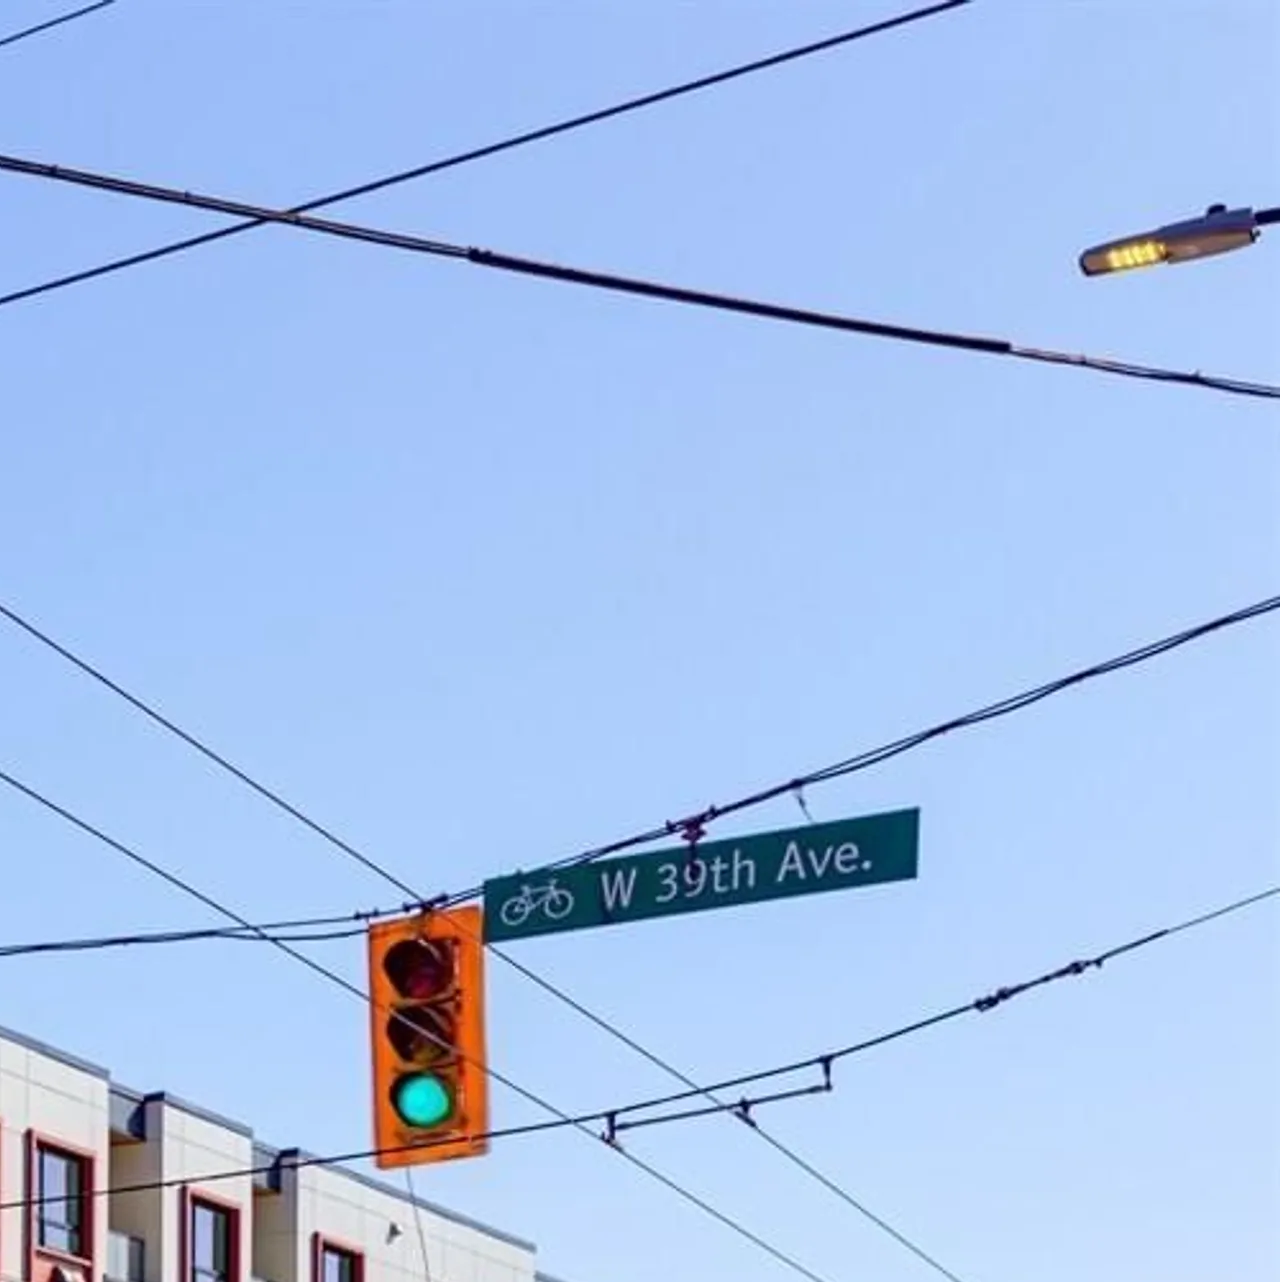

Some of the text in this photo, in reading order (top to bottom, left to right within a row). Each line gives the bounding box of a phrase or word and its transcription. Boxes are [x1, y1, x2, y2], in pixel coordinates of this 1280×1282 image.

[601, 841, 873, 911] W 39th Ave.
